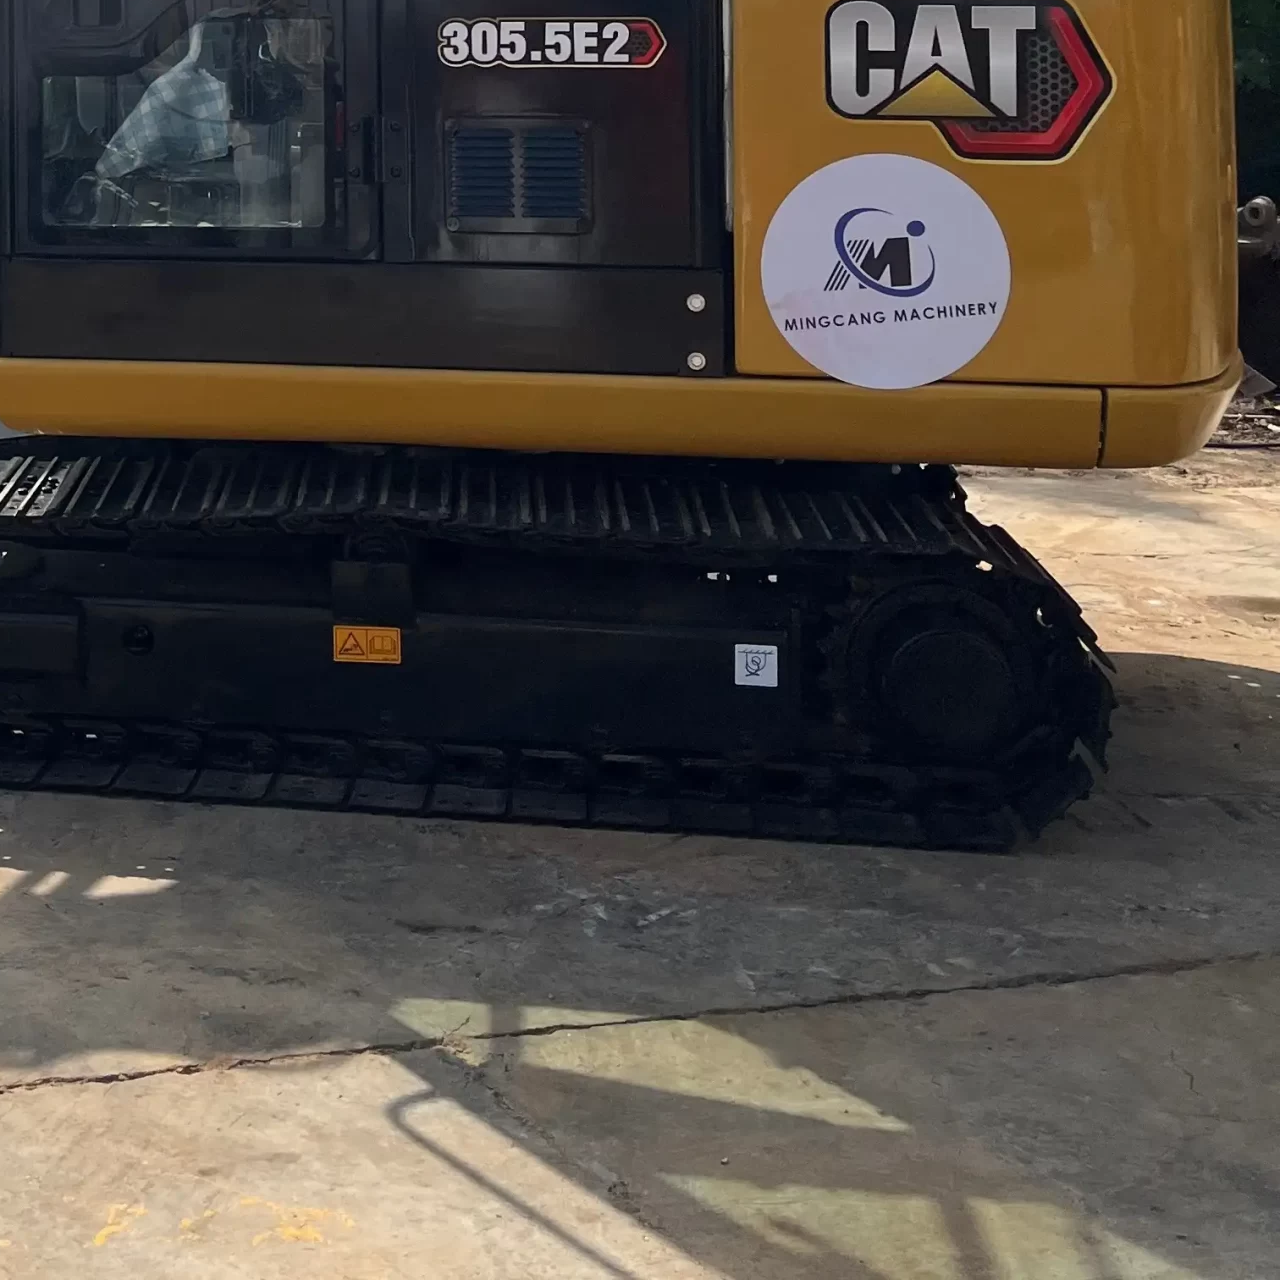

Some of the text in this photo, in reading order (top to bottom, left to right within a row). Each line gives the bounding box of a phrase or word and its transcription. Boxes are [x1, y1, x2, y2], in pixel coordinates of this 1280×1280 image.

[442, 22, 630, 62] 305.5E2
[829, 0, 1036, 117] CAT
[784, 302, 998, 331] MINGCANG MACHINERY
